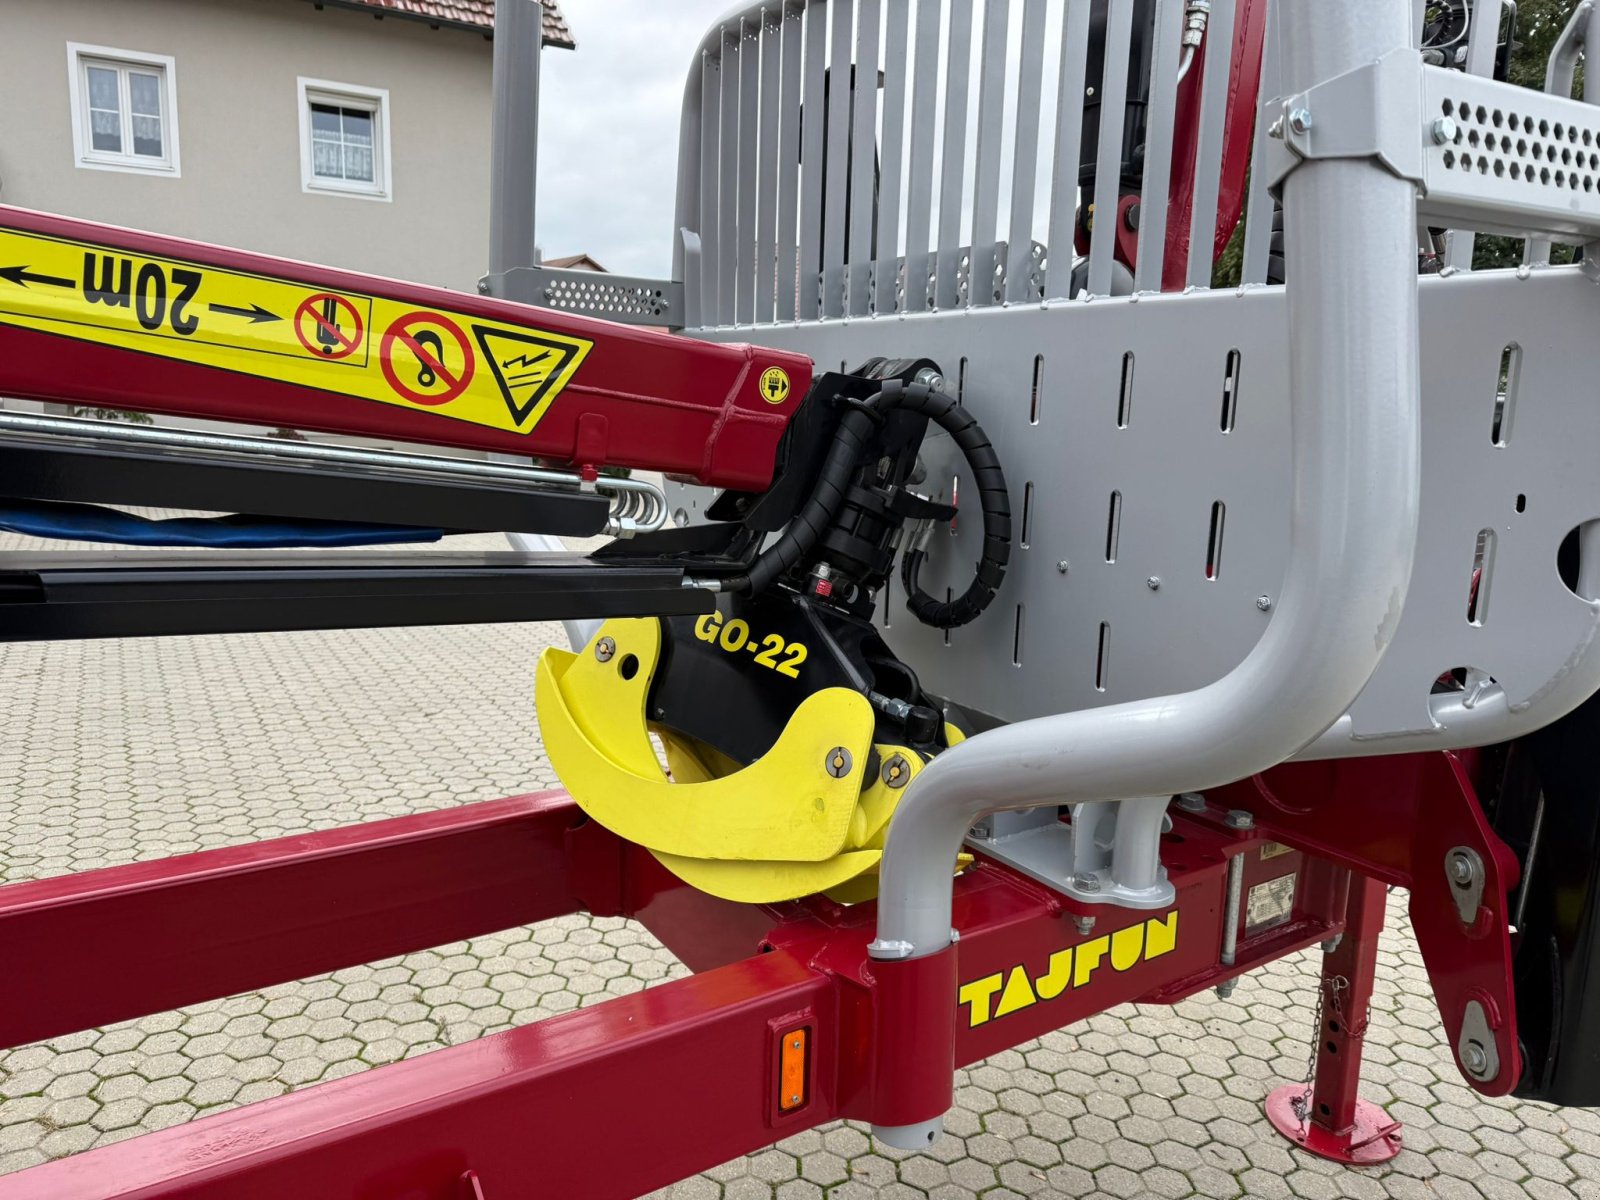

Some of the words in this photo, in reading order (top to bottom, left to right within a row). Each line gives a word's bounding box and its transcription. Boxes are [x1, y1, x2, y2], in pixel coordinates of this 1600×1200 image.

[82, 252, 203, 336] 20m
[694, 610, 808, 679] GO-22
[958, 910, 1179, 1028] TAJFUN
